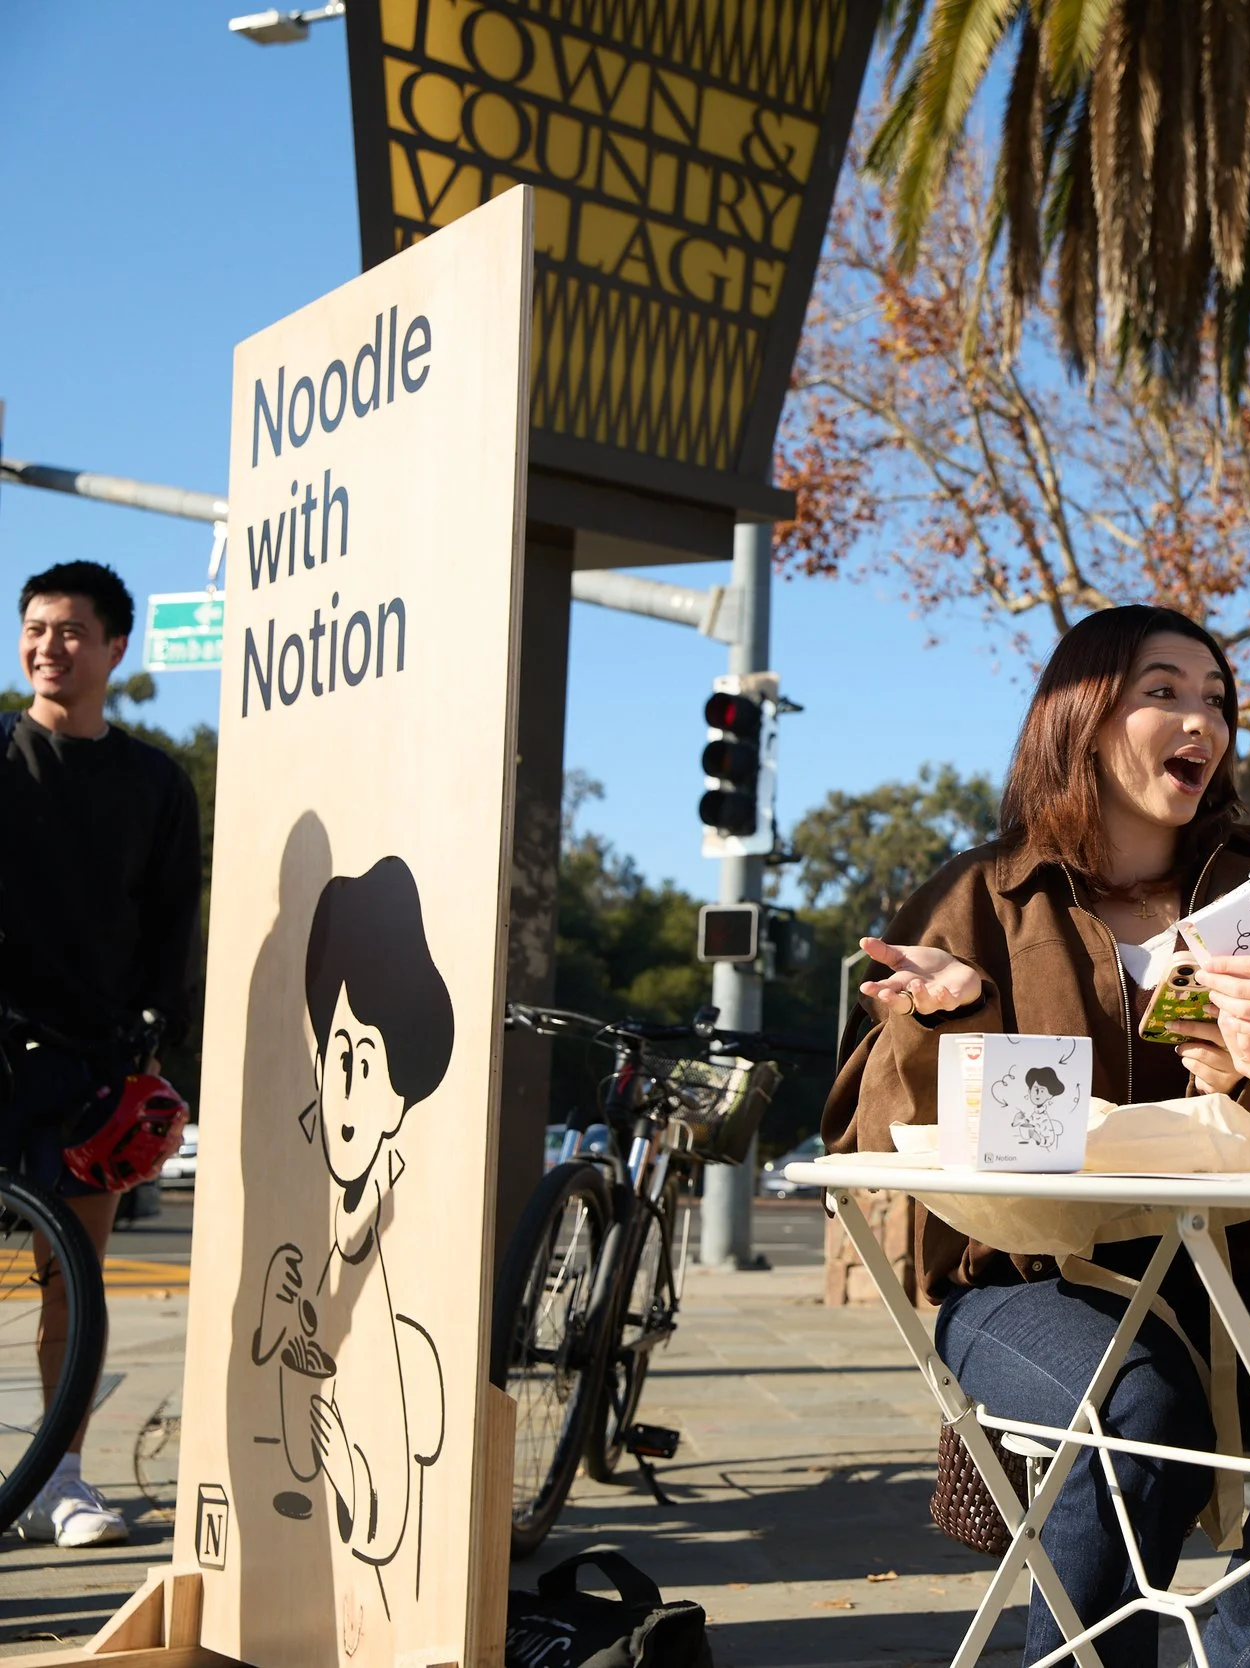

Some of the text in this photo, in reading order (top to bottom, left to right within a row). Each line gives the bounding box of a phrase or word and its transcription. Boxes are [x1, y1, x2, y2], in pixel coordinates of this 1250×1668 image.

[399, 70, 801, 252] COUNTRY
[741, 105, 802, 185] &
[399, 142, 778, 320] VILAGE
[251, 304, 432, 468] Noodle
[246, 468, 350, 591] with
[241, 591, 406, 719] Notion
[995, 1154, 1017, 1162] Notion
